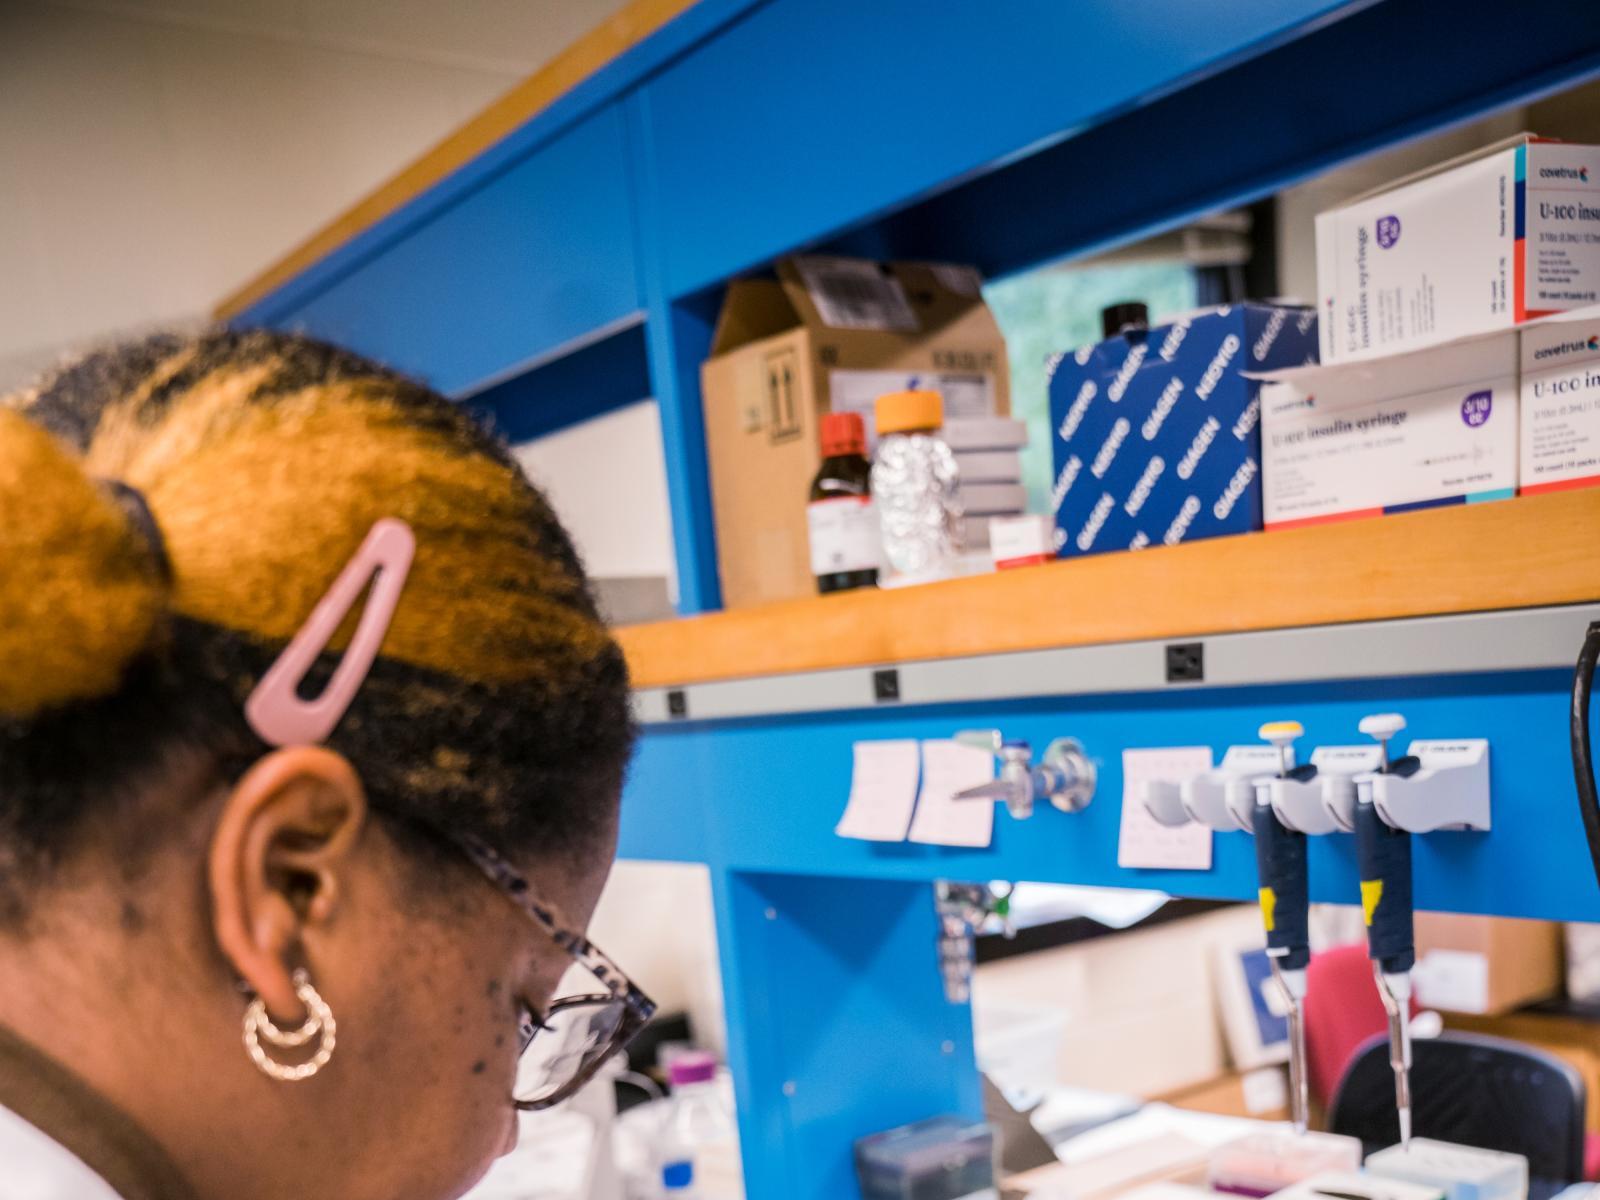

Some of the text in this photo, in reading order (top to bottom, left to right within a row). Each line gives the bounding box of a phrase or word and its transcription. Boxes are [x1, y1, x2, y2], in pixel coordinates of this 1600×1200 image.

[1539, 167, 1578, 179] covetrus
[1540, 201, 1575, 220] U-100
[1195, 334, 1240, 401] QIAGEN
[1534, 341, 1585, 360] covetrus
[1059, 380, 1097, 441] QIAGEN
[1142, 376, 1184, 440] QIAGEN
[1534, 378, 1581, 398] U-100
[1091, 417, 1130, 479] QIAGEN
[1177, 415, 1220, 479] QIAGEN
[1308, 419, 1353, 439] insulin
[1356, 411, 1407, 432] syringe
[1124, 455, 1165, 517] QIAGEN
[1214, 456, 1257, 519] QIAGEN
[1077, 491, 1115, 551] QIAGEN
